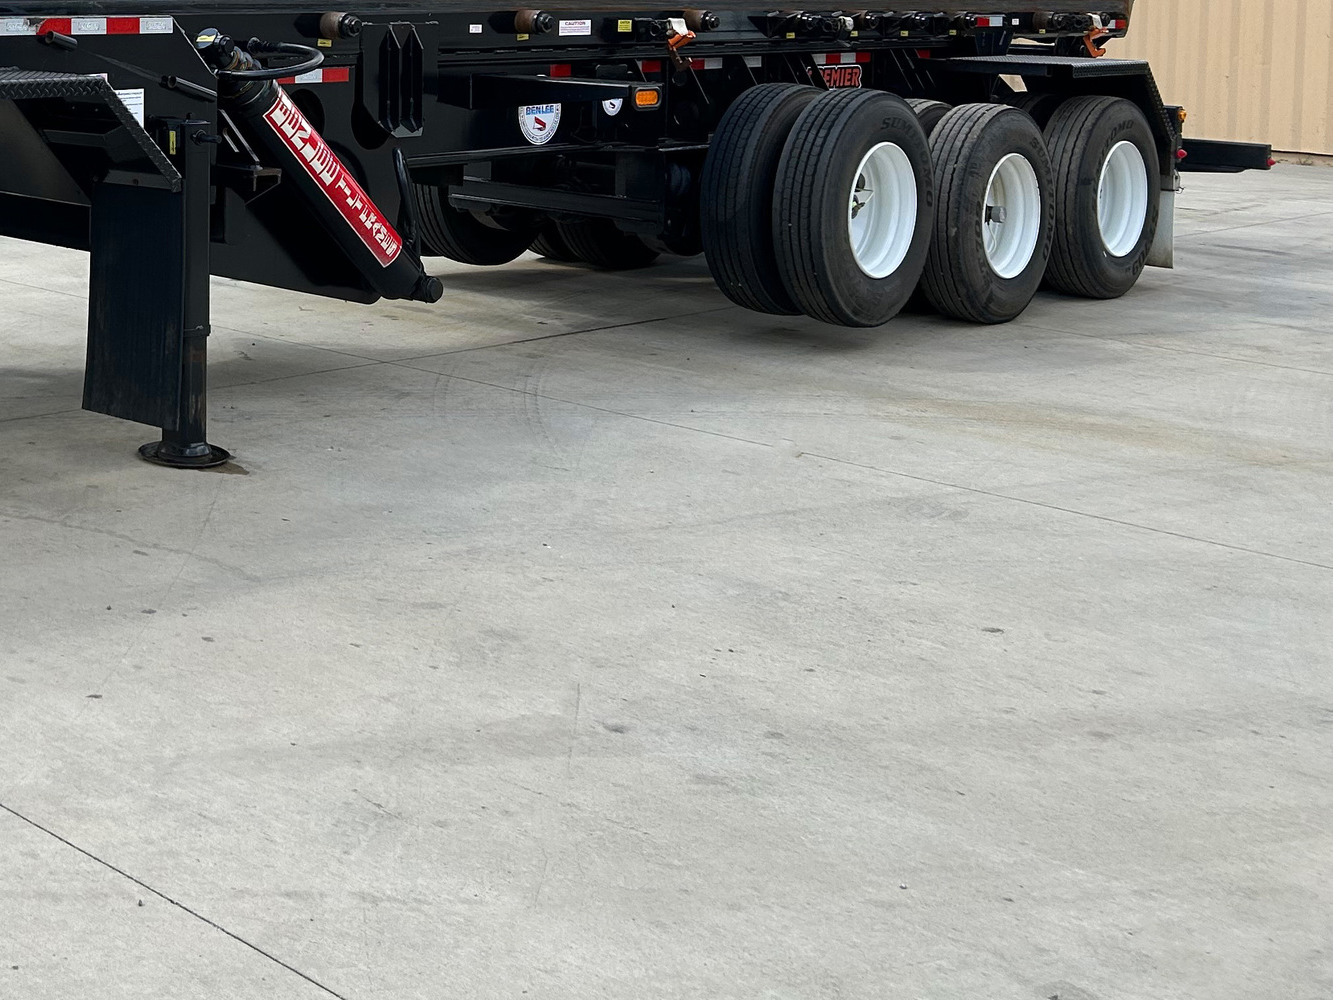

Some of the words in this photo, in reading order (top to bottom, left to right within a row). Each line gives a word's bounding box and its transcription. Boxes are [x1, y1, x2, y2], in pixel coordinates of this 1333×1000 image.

[808, 68, 860, 87] EMIER
[526, 104, 555, 116] BENLEE
[270, 93, 340, 186] BENLEE
[1029, 136, 1055, 261] SUMITOMO
